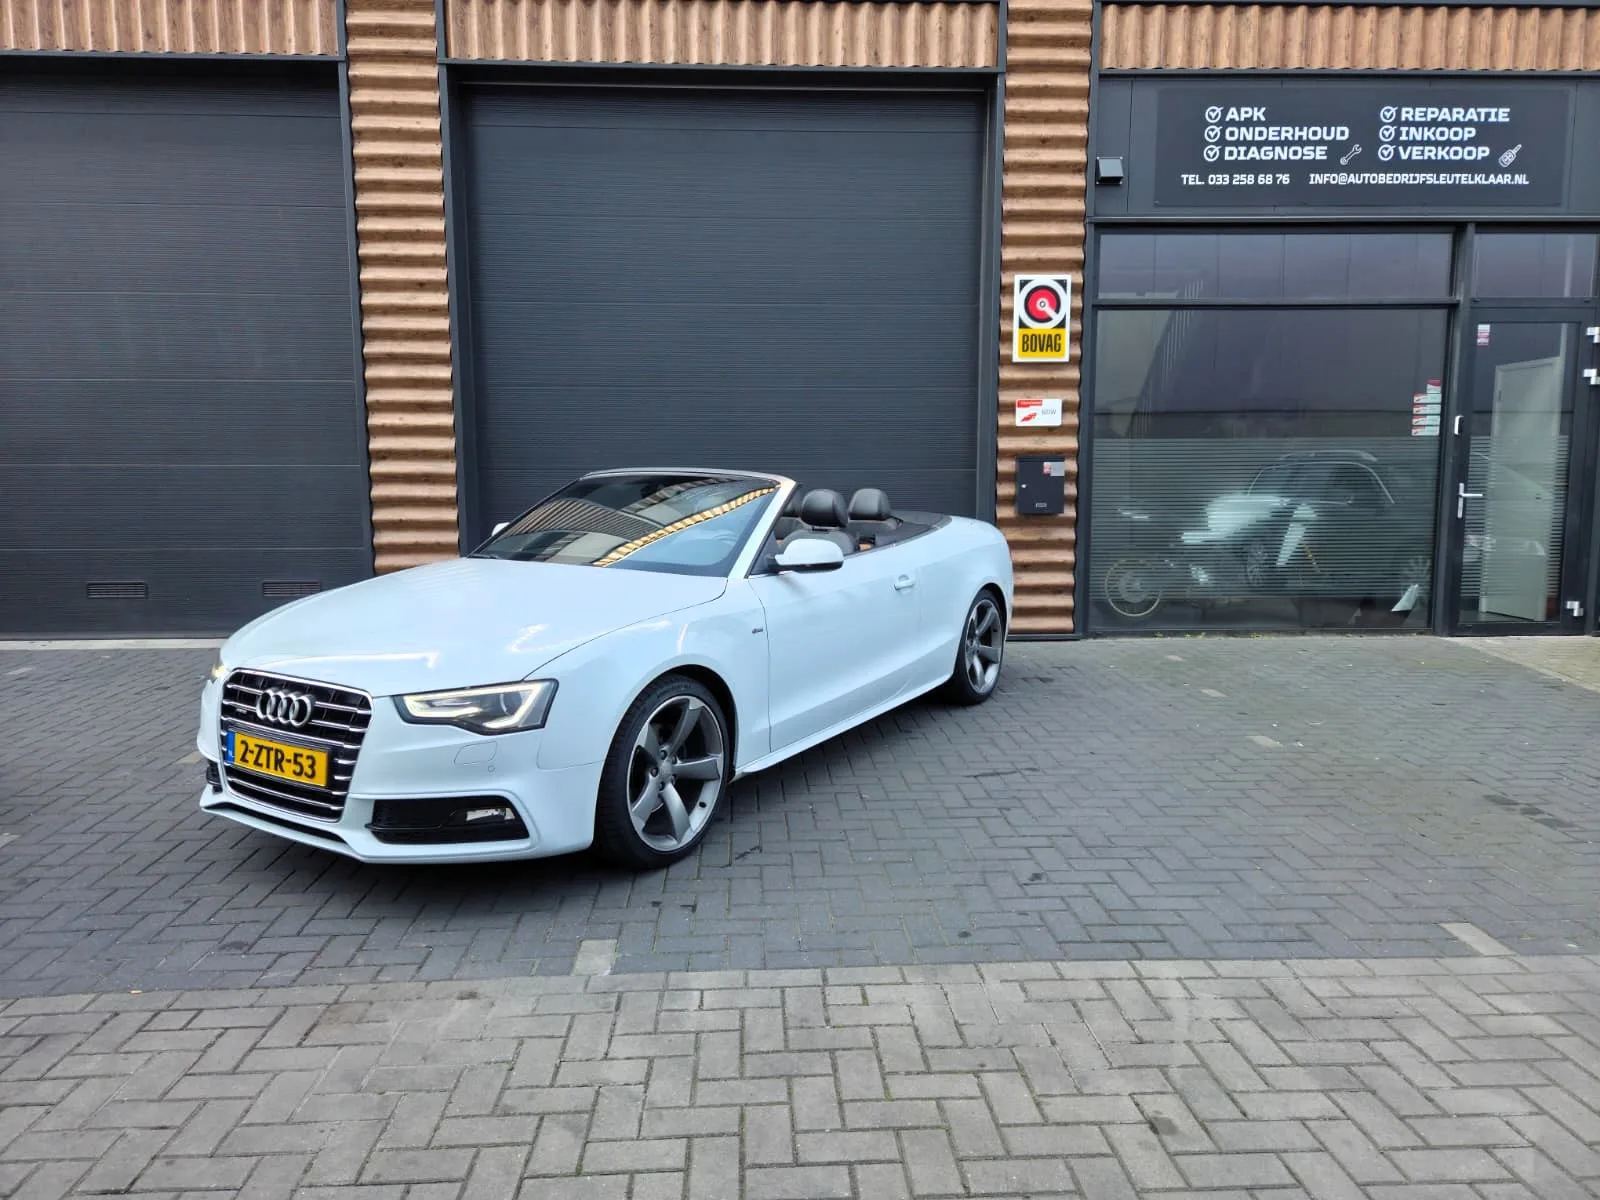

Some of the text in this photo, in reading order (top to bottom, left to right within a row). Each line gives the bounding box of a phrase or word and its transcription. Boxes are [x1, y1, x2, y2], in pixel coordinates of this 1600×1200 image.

[1225, 107, 1266, 122] APK
[1401, 107, 1511, 122] REPARATIE
[1225, 126, 1350, 141] ONDERHOUD
[1399, 126, 1476, 141] INKOOP
[1224, 146, 1328, 160] DIAGNOSE
[1399, 146, 1490, 160] VERKOOP
[1181, 174, 1290, 185] TEL. 033 258 68 76
[1309, 173, 1530, 185] INFO@AUTOBEDRIJFSLEUTELKLAAR.NL
[1021, 333, 1061, 353] BOVAG
[239, 739, 317, 780] 2-ZTR-53
